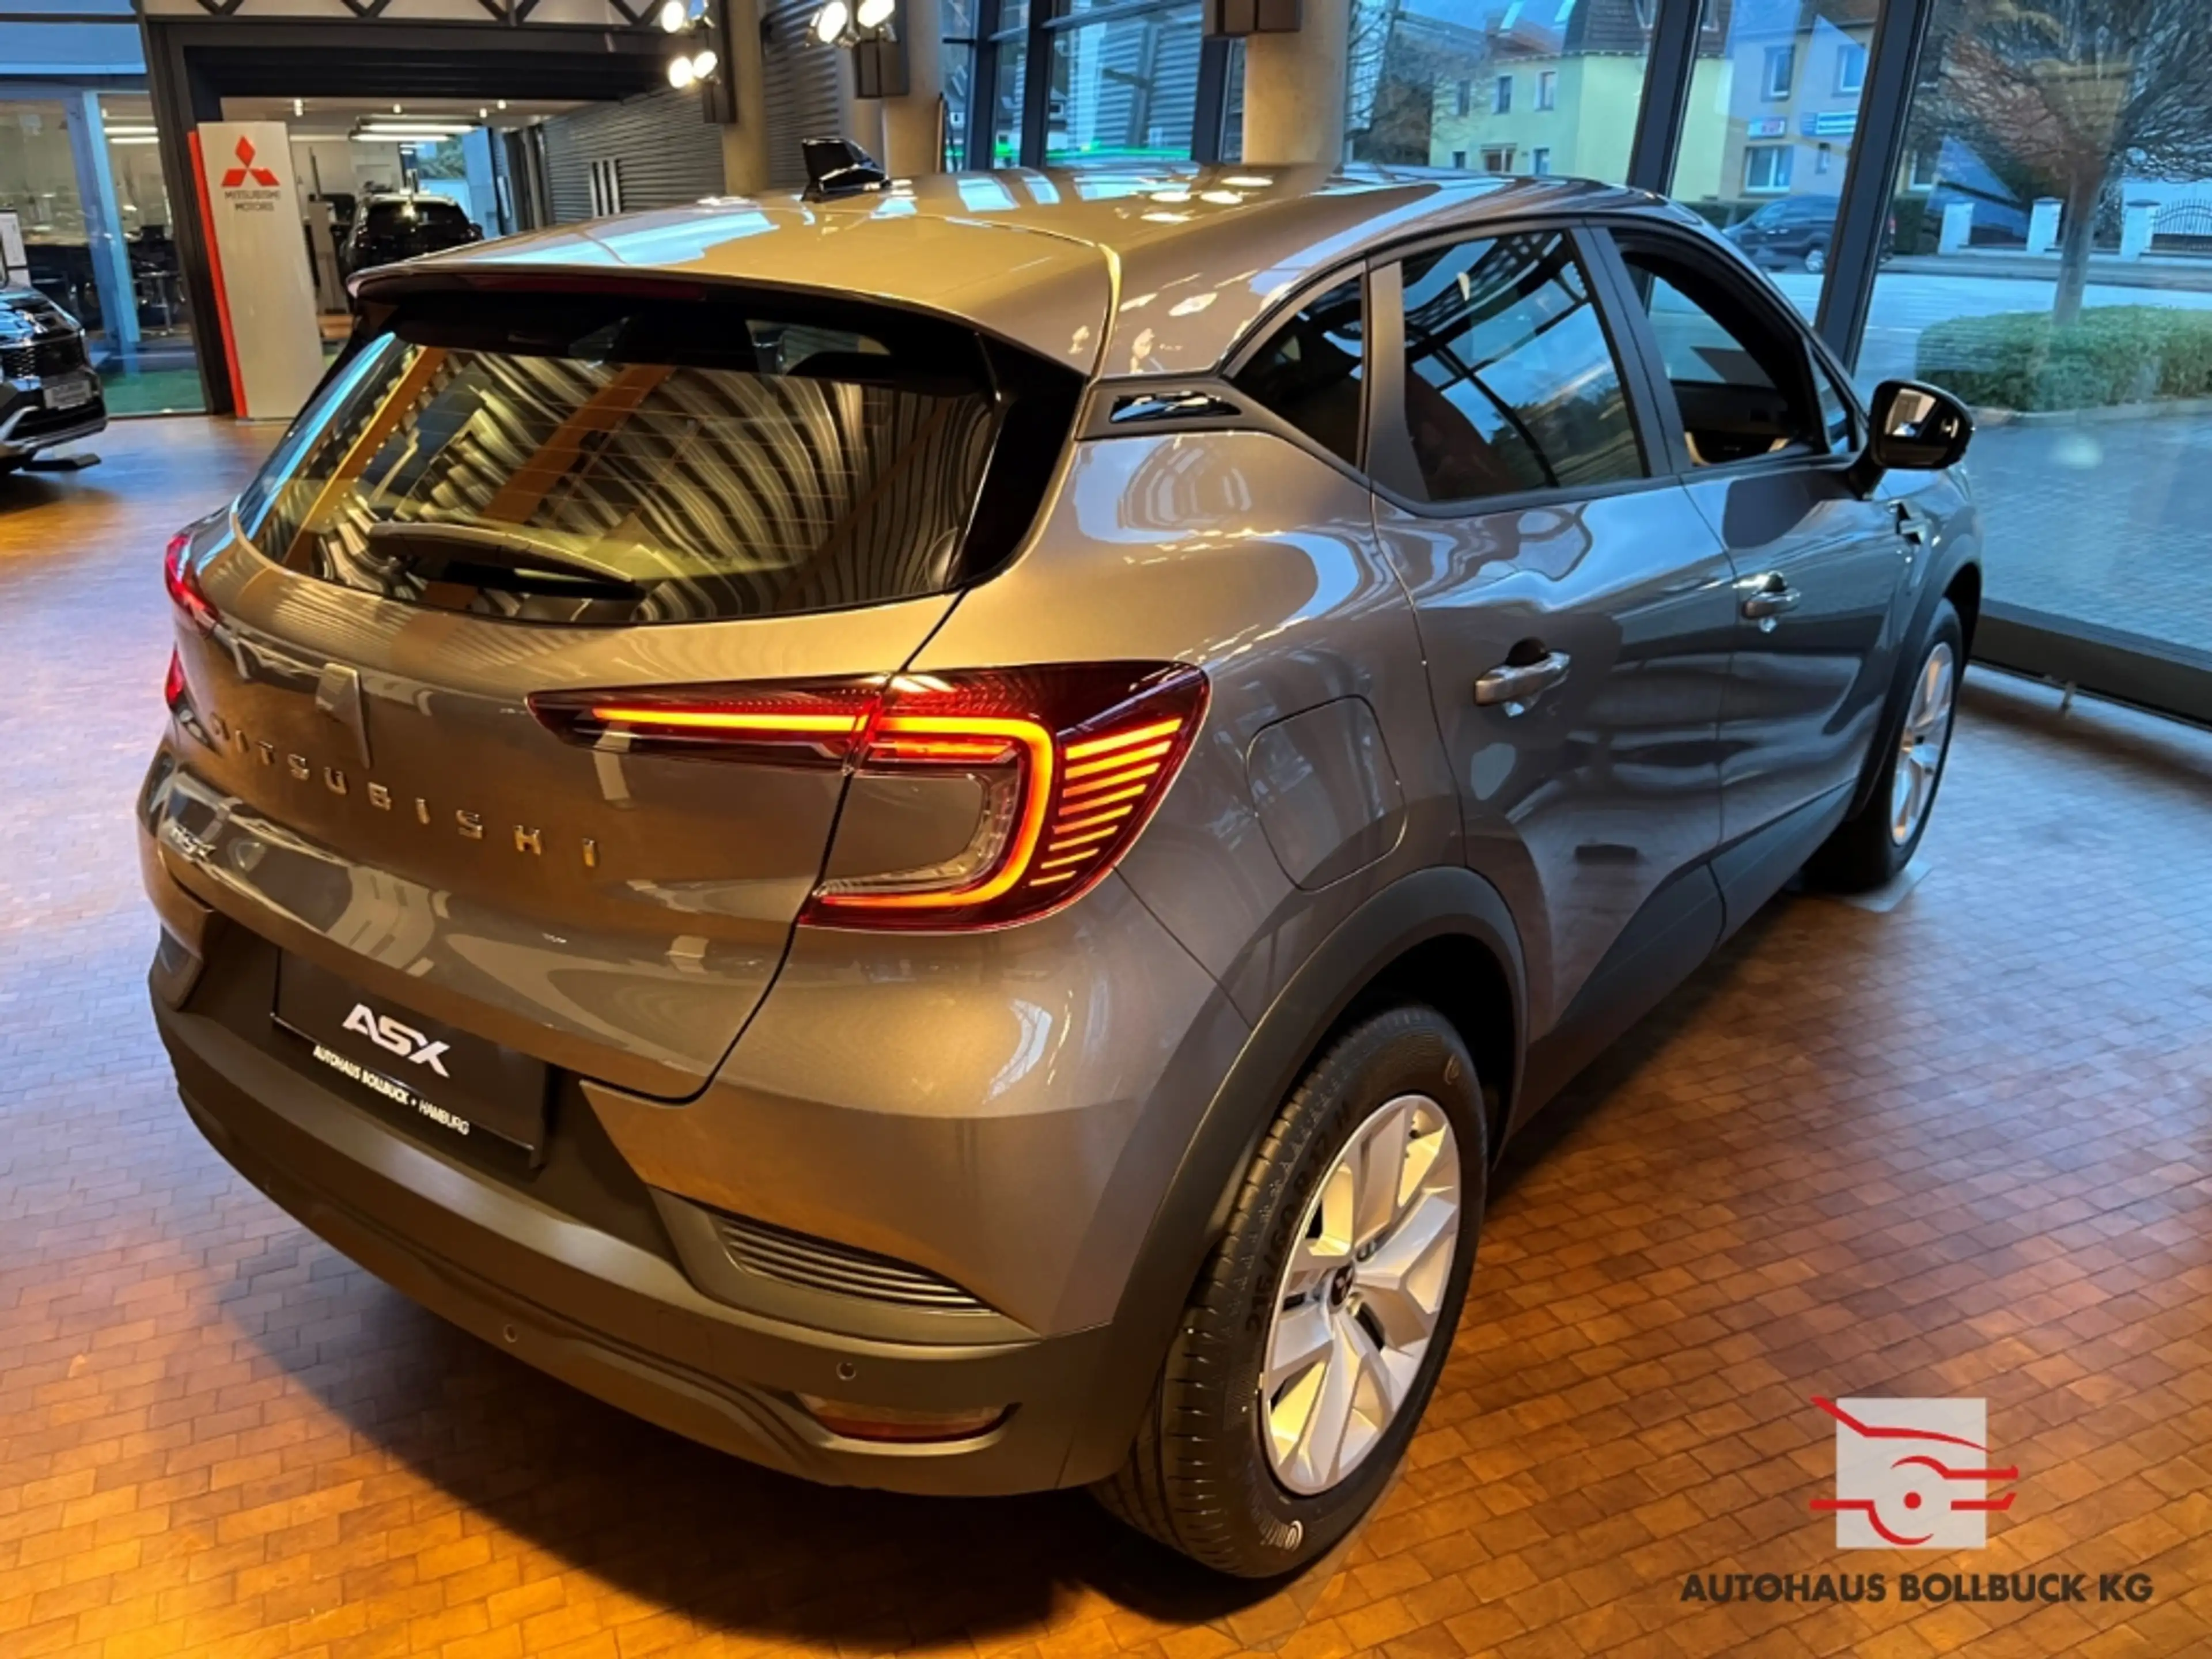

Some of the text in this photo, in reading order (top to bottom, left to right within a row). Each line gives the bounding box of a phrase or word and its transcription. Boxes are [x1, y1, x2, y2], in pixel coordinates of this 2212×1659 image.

[210, 711, 597, 868] MITSUBISHI
[341, 1003, 450, 1078] ASX
[313, 1044, 470, 1135] AUTOHAUS BOLLBUCK HAMBURG
